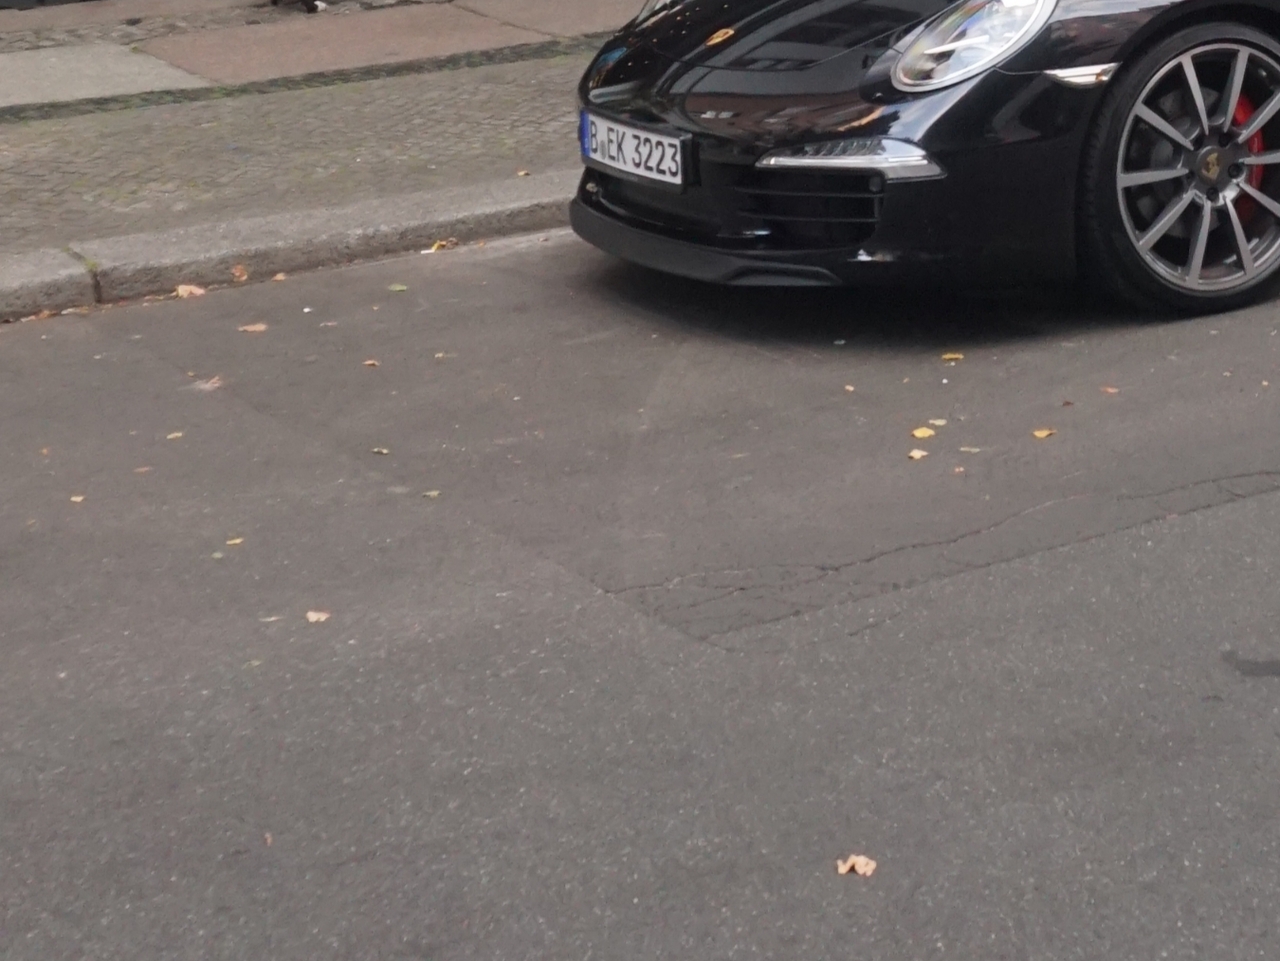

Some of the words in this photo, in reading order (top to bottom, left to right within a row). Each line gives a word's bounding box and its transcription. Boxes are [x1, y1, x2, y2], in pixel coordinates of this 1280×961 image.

[590, 120, 599, 155] B
[606, 126, 628, 166] EK
[631, 134, 680, 178] 3223
